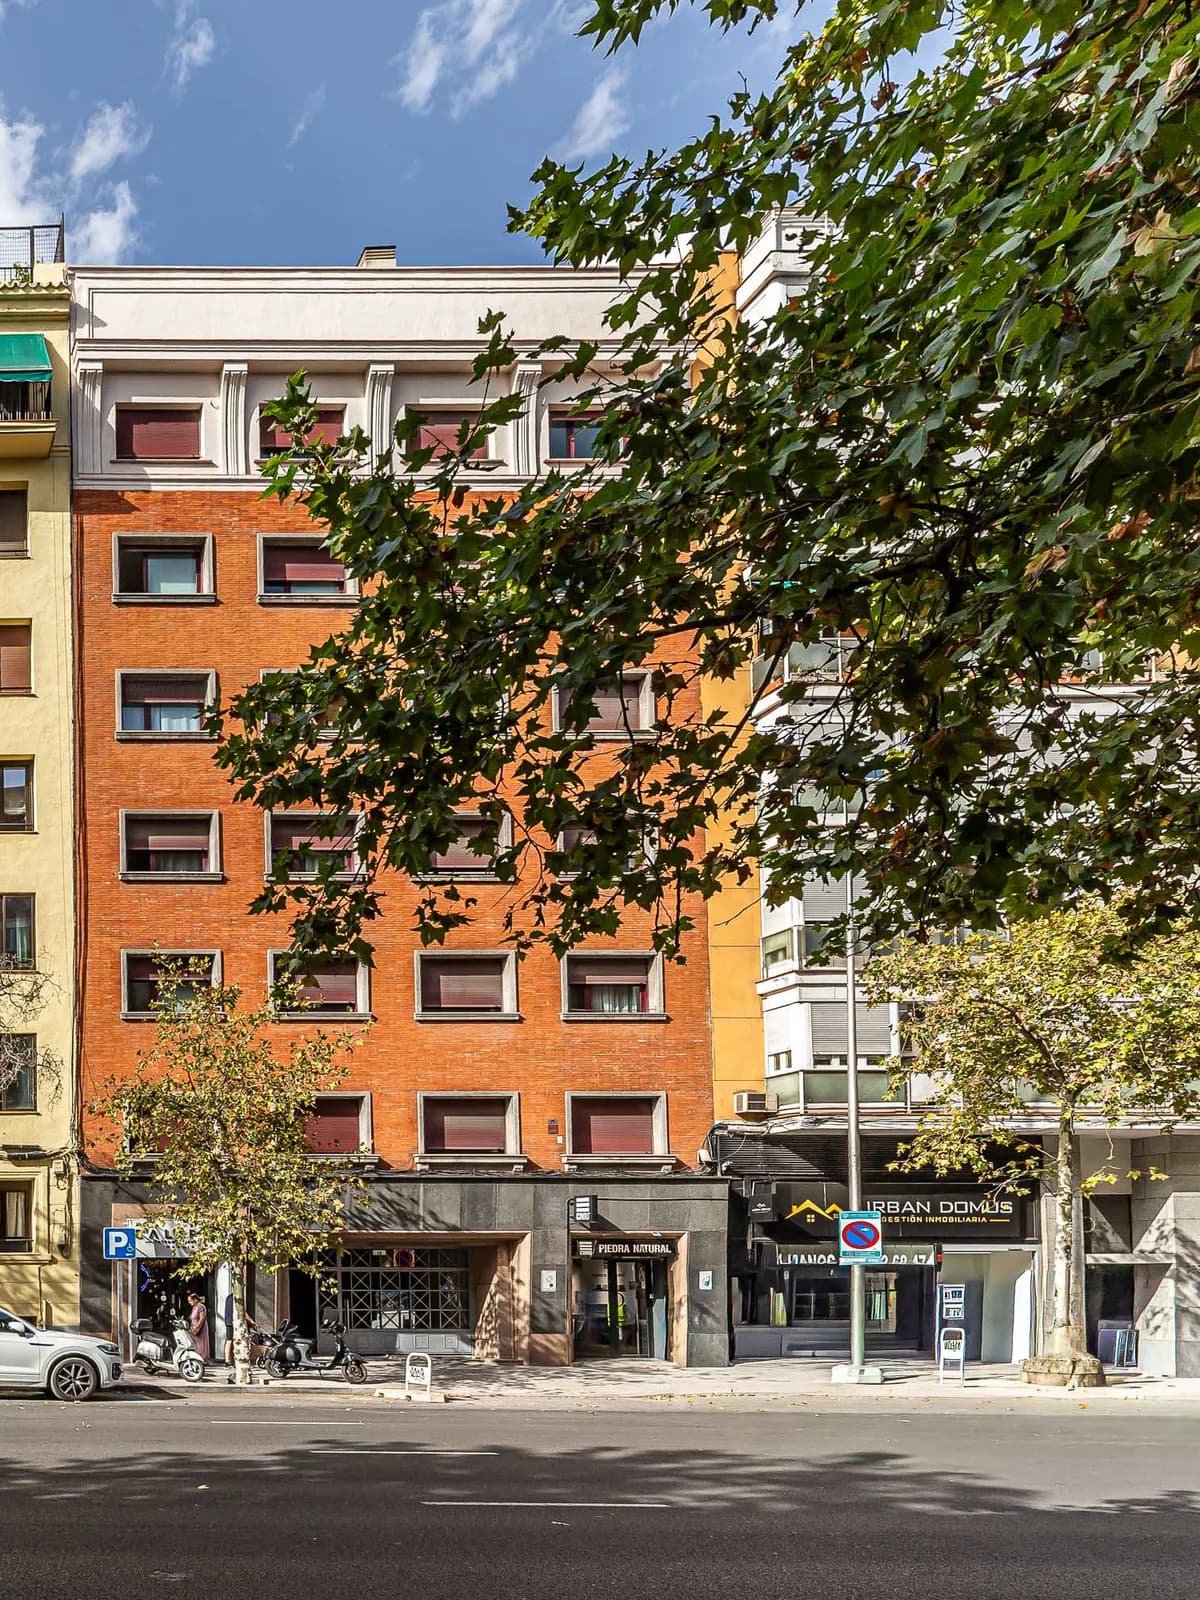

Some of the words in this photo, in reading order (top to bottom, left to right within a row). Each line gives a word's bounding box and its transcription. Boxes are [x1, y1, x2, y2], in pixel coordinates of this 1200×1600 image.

[940, 1201, 1013, 1214] DOMUS
[109, 1231, 128, 1256] P
[598, 1244, 630, 1254] PIEDRA
[633, 1244, 672, 1253] NATURAL
